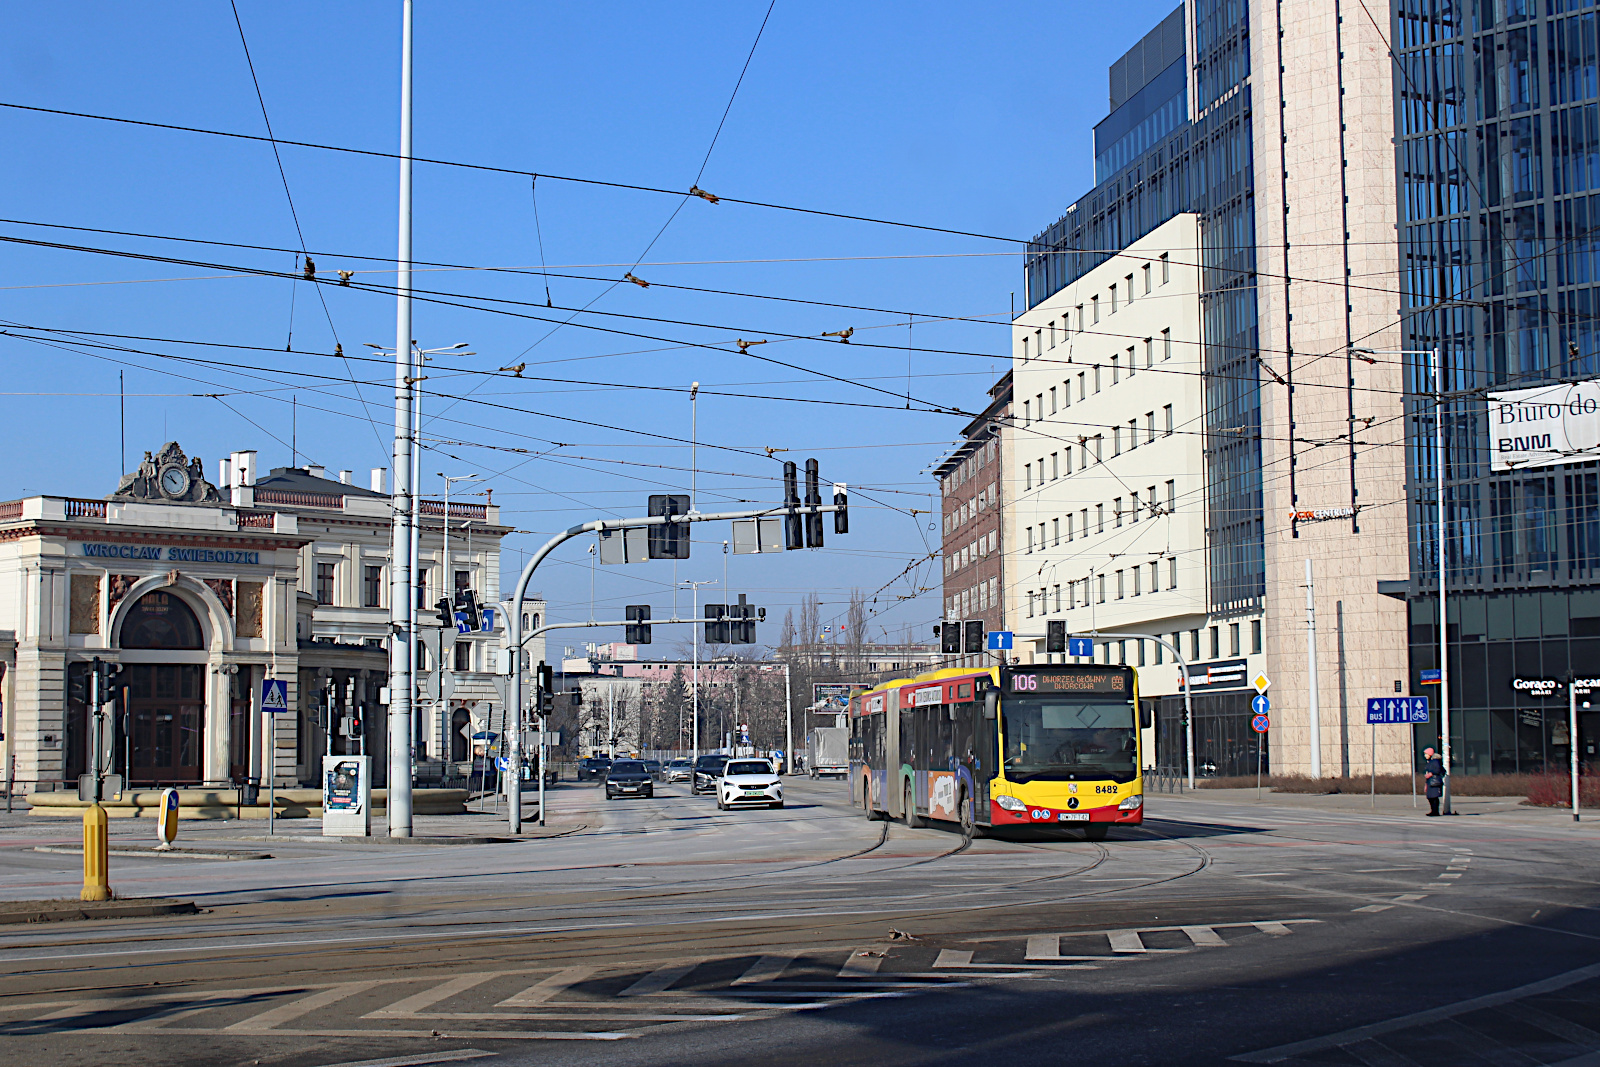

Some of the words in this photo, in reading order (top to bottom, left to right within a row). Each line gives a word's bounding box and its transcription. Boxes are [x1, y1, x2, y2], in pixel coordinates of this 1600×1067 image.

[1498, 403, 1561, 424] Biuro
[1569, 394, 1597, 416] do
[1499, 433, 1552, 453] BNM
[83, 543, 163, 560] WROCŁAW
[168, 546, 259, 565] ŚWIEBODZKI
[1012, 674, 1037, 691] 106
[1042, 675, 1074, 684] DWORZEC
[1076, 674, 1107, 684] GŁÓWNY
[1054, 682, 1095, 690] DWORCOWA
[1513, 678, 1556, 690] Gorąco
[1369, 713, 1383, 721] BUS
[1095, 785, 1118, 794] 8482
